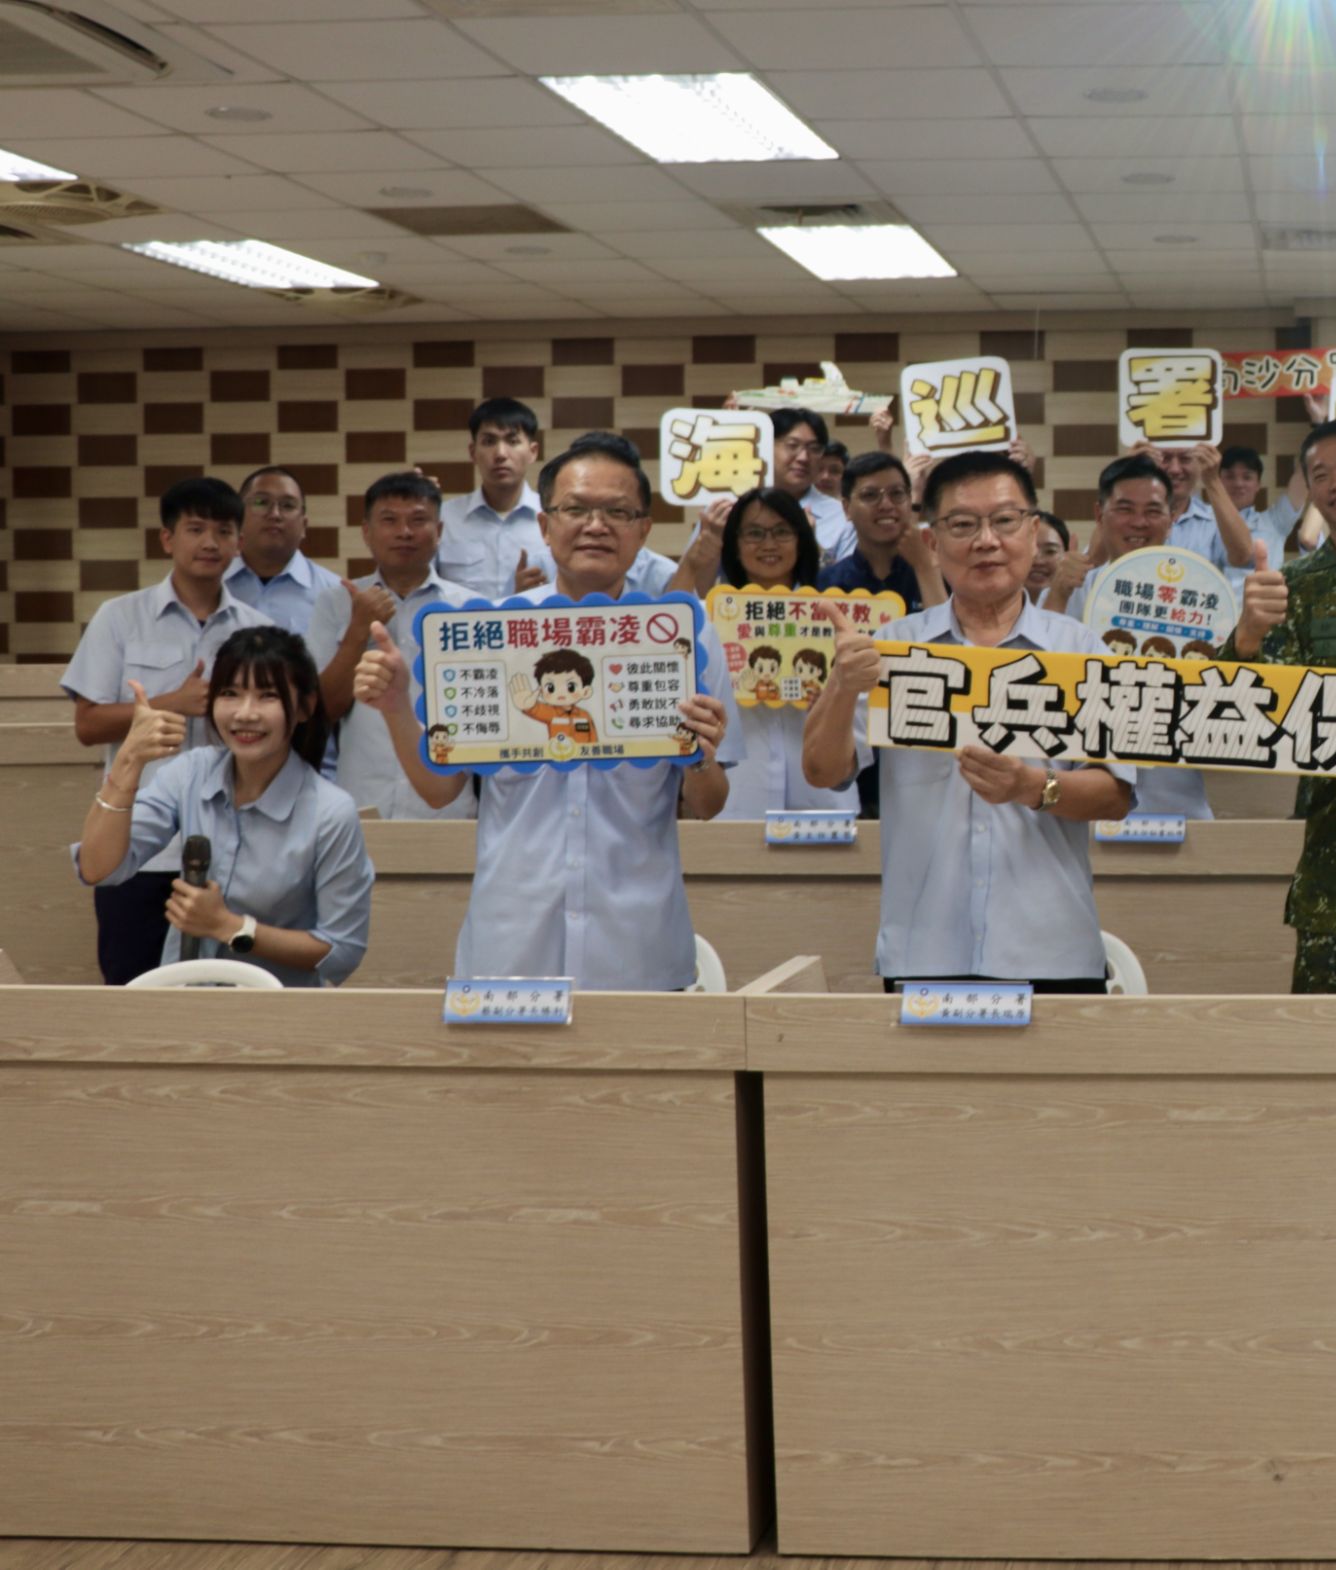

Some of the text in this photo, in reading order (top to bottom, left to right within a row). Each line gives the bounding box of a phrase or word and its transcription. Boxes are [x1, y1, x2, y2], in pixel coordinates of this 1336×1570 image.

[1128, 356, 1217, 443] 署
[910, 368, 1009, 450] 巡
[671, 415, 766, 498] 海
[1114, 579, 1219, 611] 職場零霸凌
[439, 613, 641, 652] 拒絕職場霸凌
[460, 668, 498, 682] 不霸凌
[627, 661, 680, 675] 彼此關懷
[461, 686, 499, 700] 不冷落
[627, 679, 680, 693] 尊重包容
[461, 704, 500, 718] 不歧視
[628, 697, 680, 711] 勇敢說不
[462, 722, 501, 736] 不侮辱
[629, 715, 682, 729] 尋求協助
